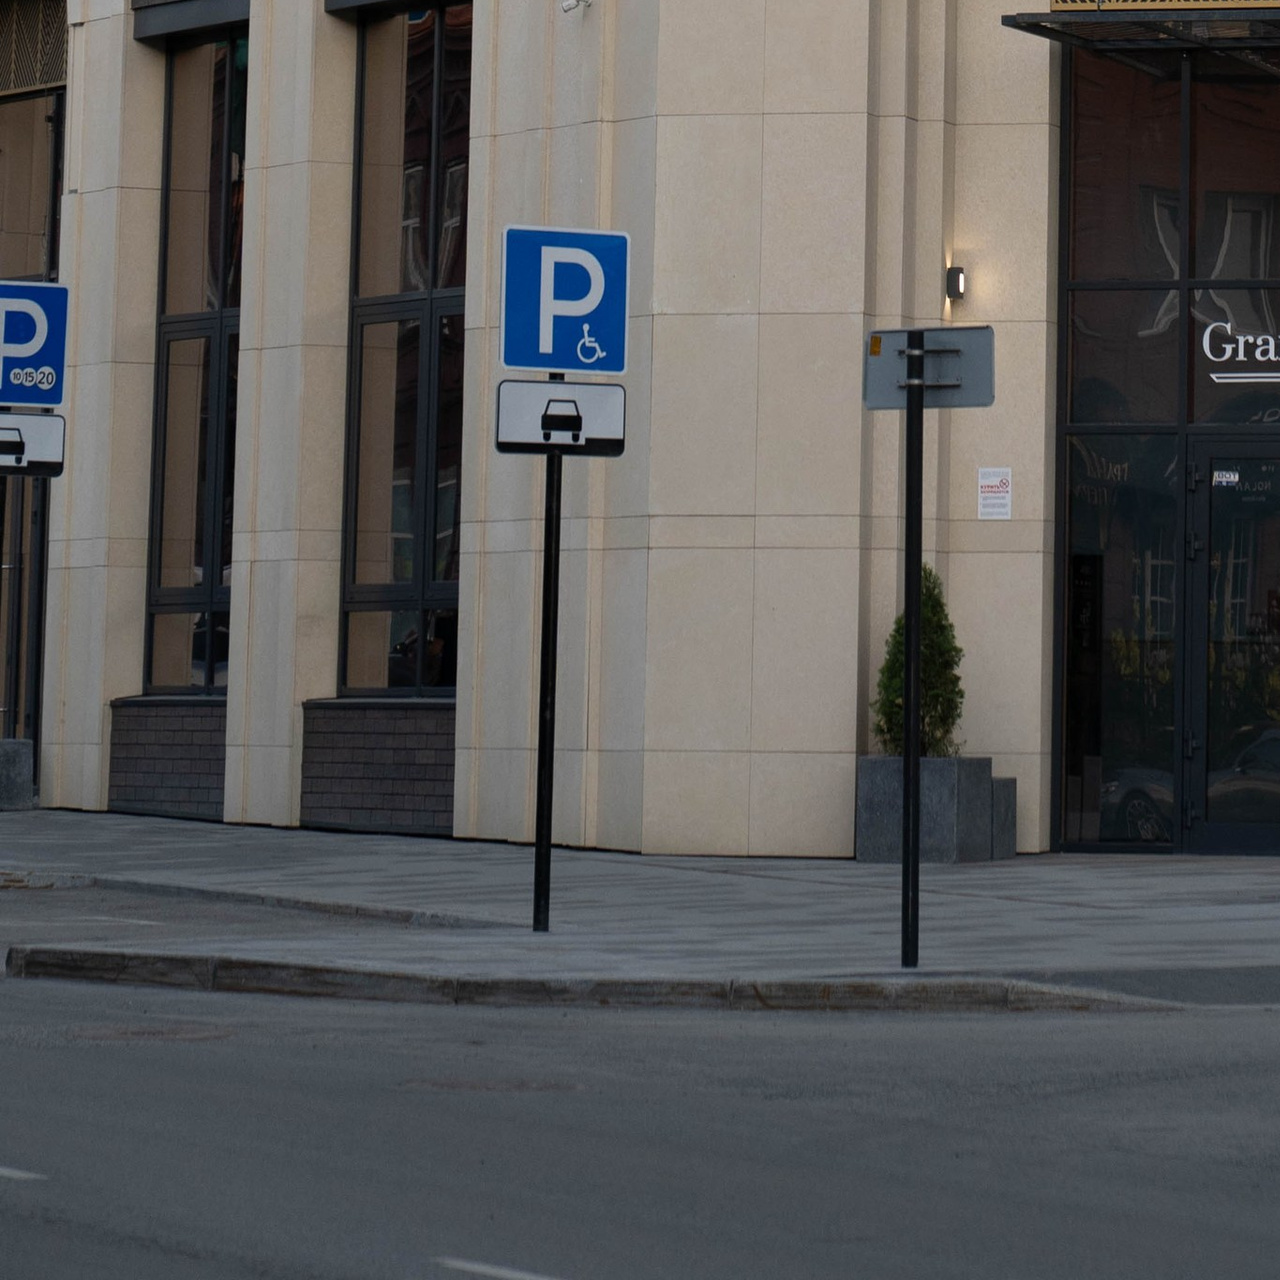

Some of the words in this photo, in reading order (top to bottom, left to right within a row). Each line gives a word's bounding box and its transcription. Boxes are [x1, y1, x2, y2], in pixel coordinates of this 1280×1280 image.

[0, 298, 48, 389] P
[539, 245, 605, 354] P
[13, 371, 21, 381] 10
[24, 371, 35, 383] 15
[37, 371, 54, 386] 20
